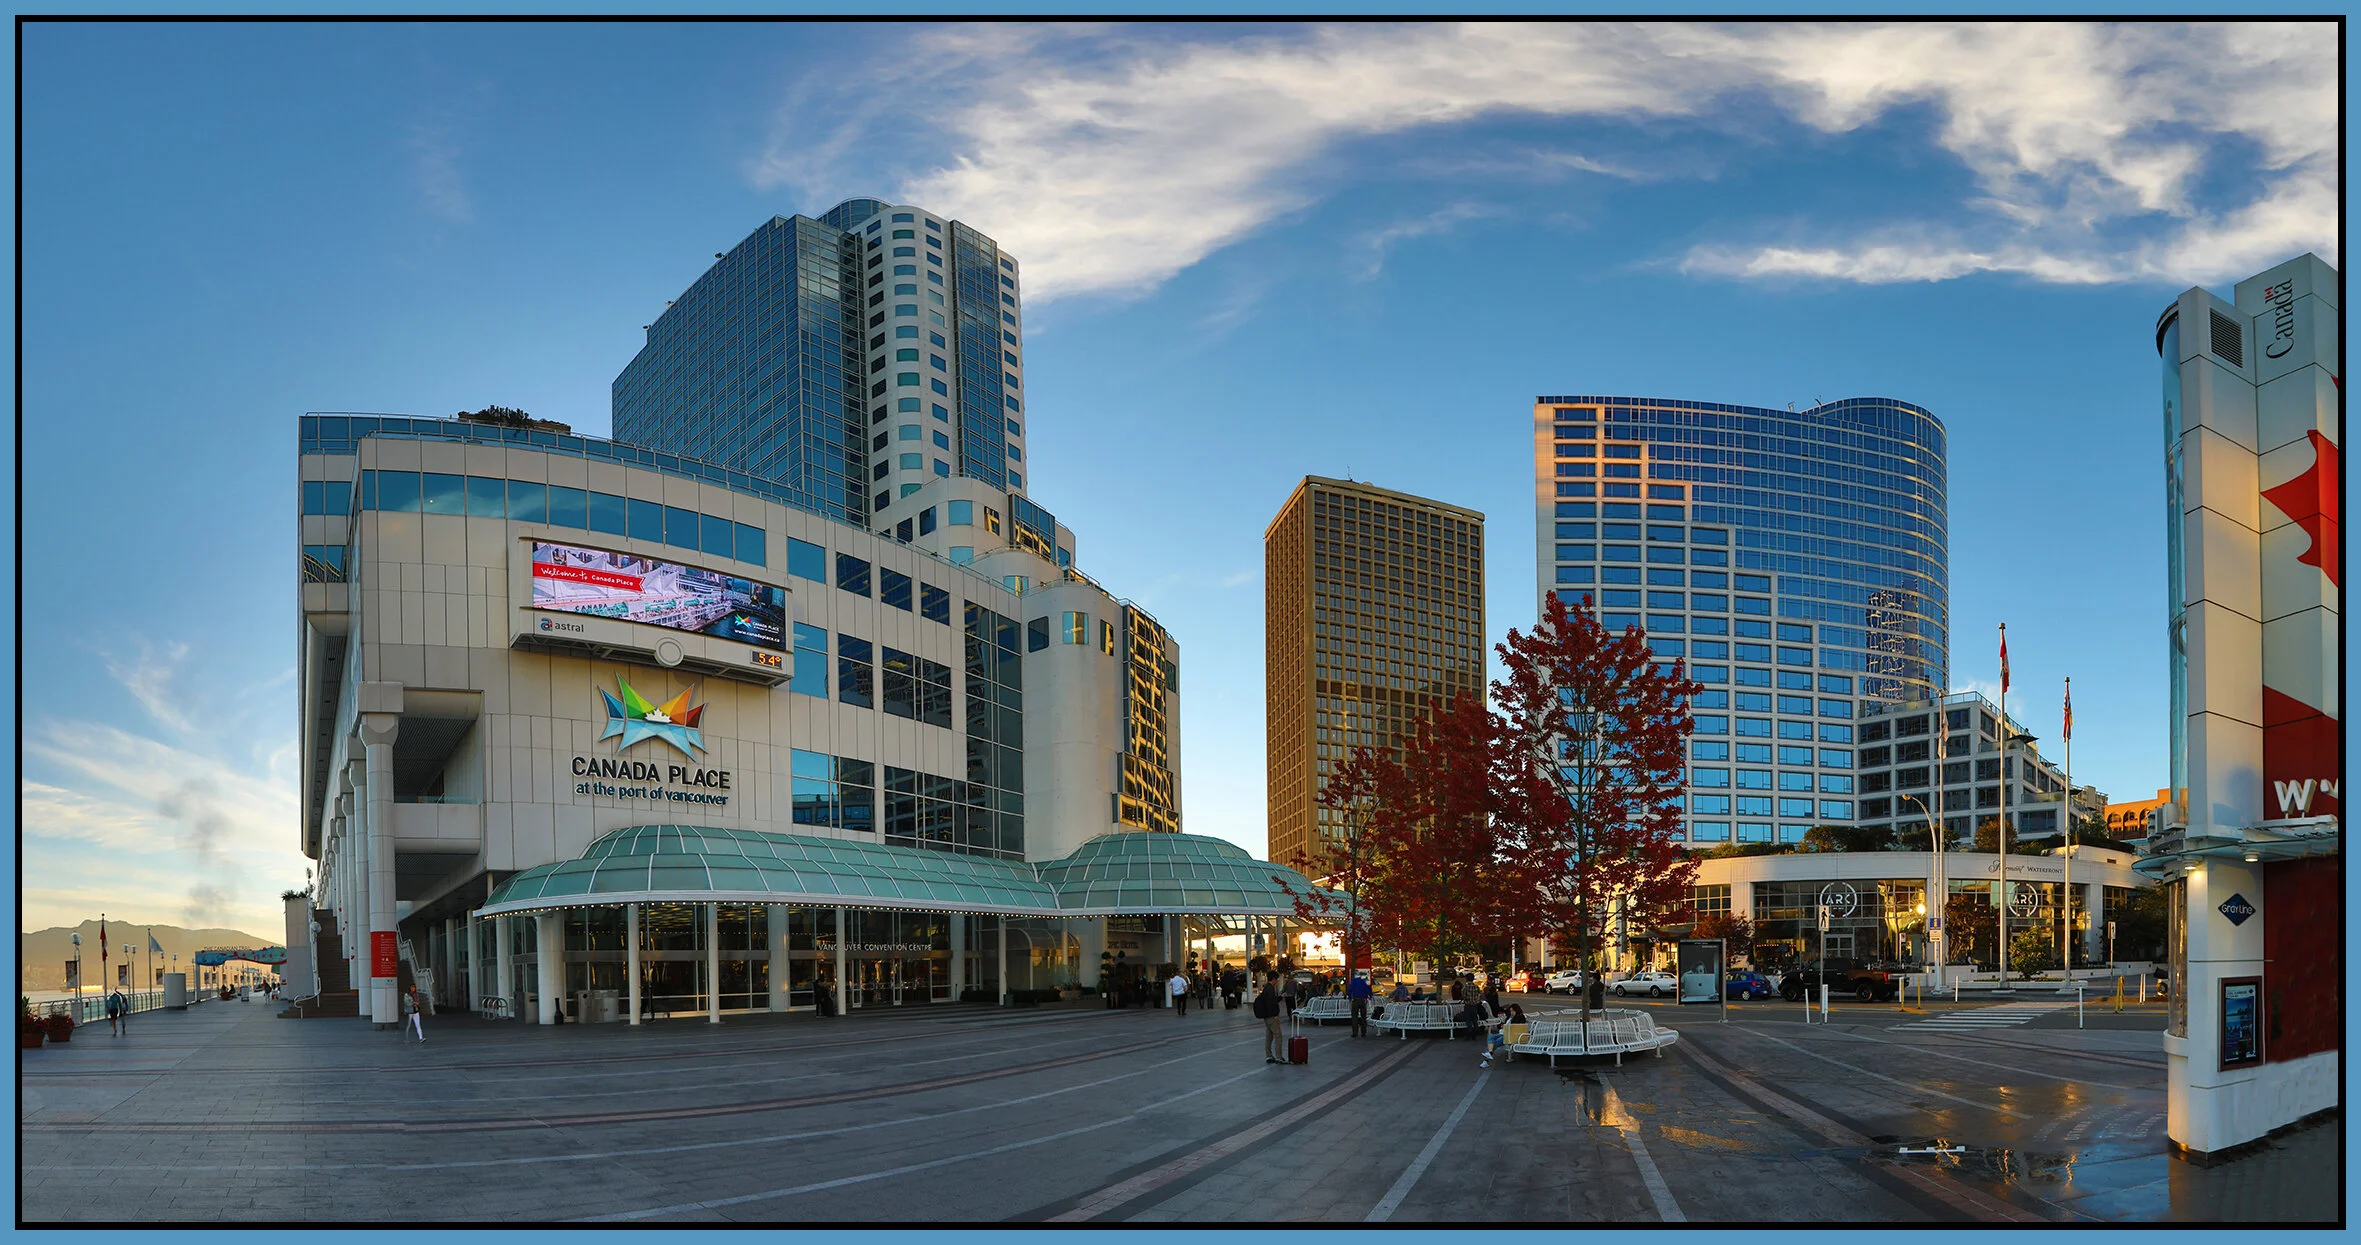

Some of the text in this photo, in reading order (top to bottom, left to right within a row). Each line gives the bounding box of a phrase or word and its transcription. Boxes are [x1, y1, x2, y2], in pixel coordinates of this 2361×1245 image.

[2264, 278, 2295, 360] Canada
[541, 567, 634, 587] Welcome to Canada Place
[575, 603, 608, 611] CANADA
[555, 622, 584, 633] astral
[572, 756, 731, 790] CANADA PLACE
[576, 781, 729, 806] at the port of vancouver
[2027, 866, 2063, 874] WATERFRONT
[1825, 893, 1851, 905] ARC
[2012, 894, 2033, 905] ARC
[864, 943, 907, 952] CONVENTION
[908, 943, 932, 952] CENTRE
